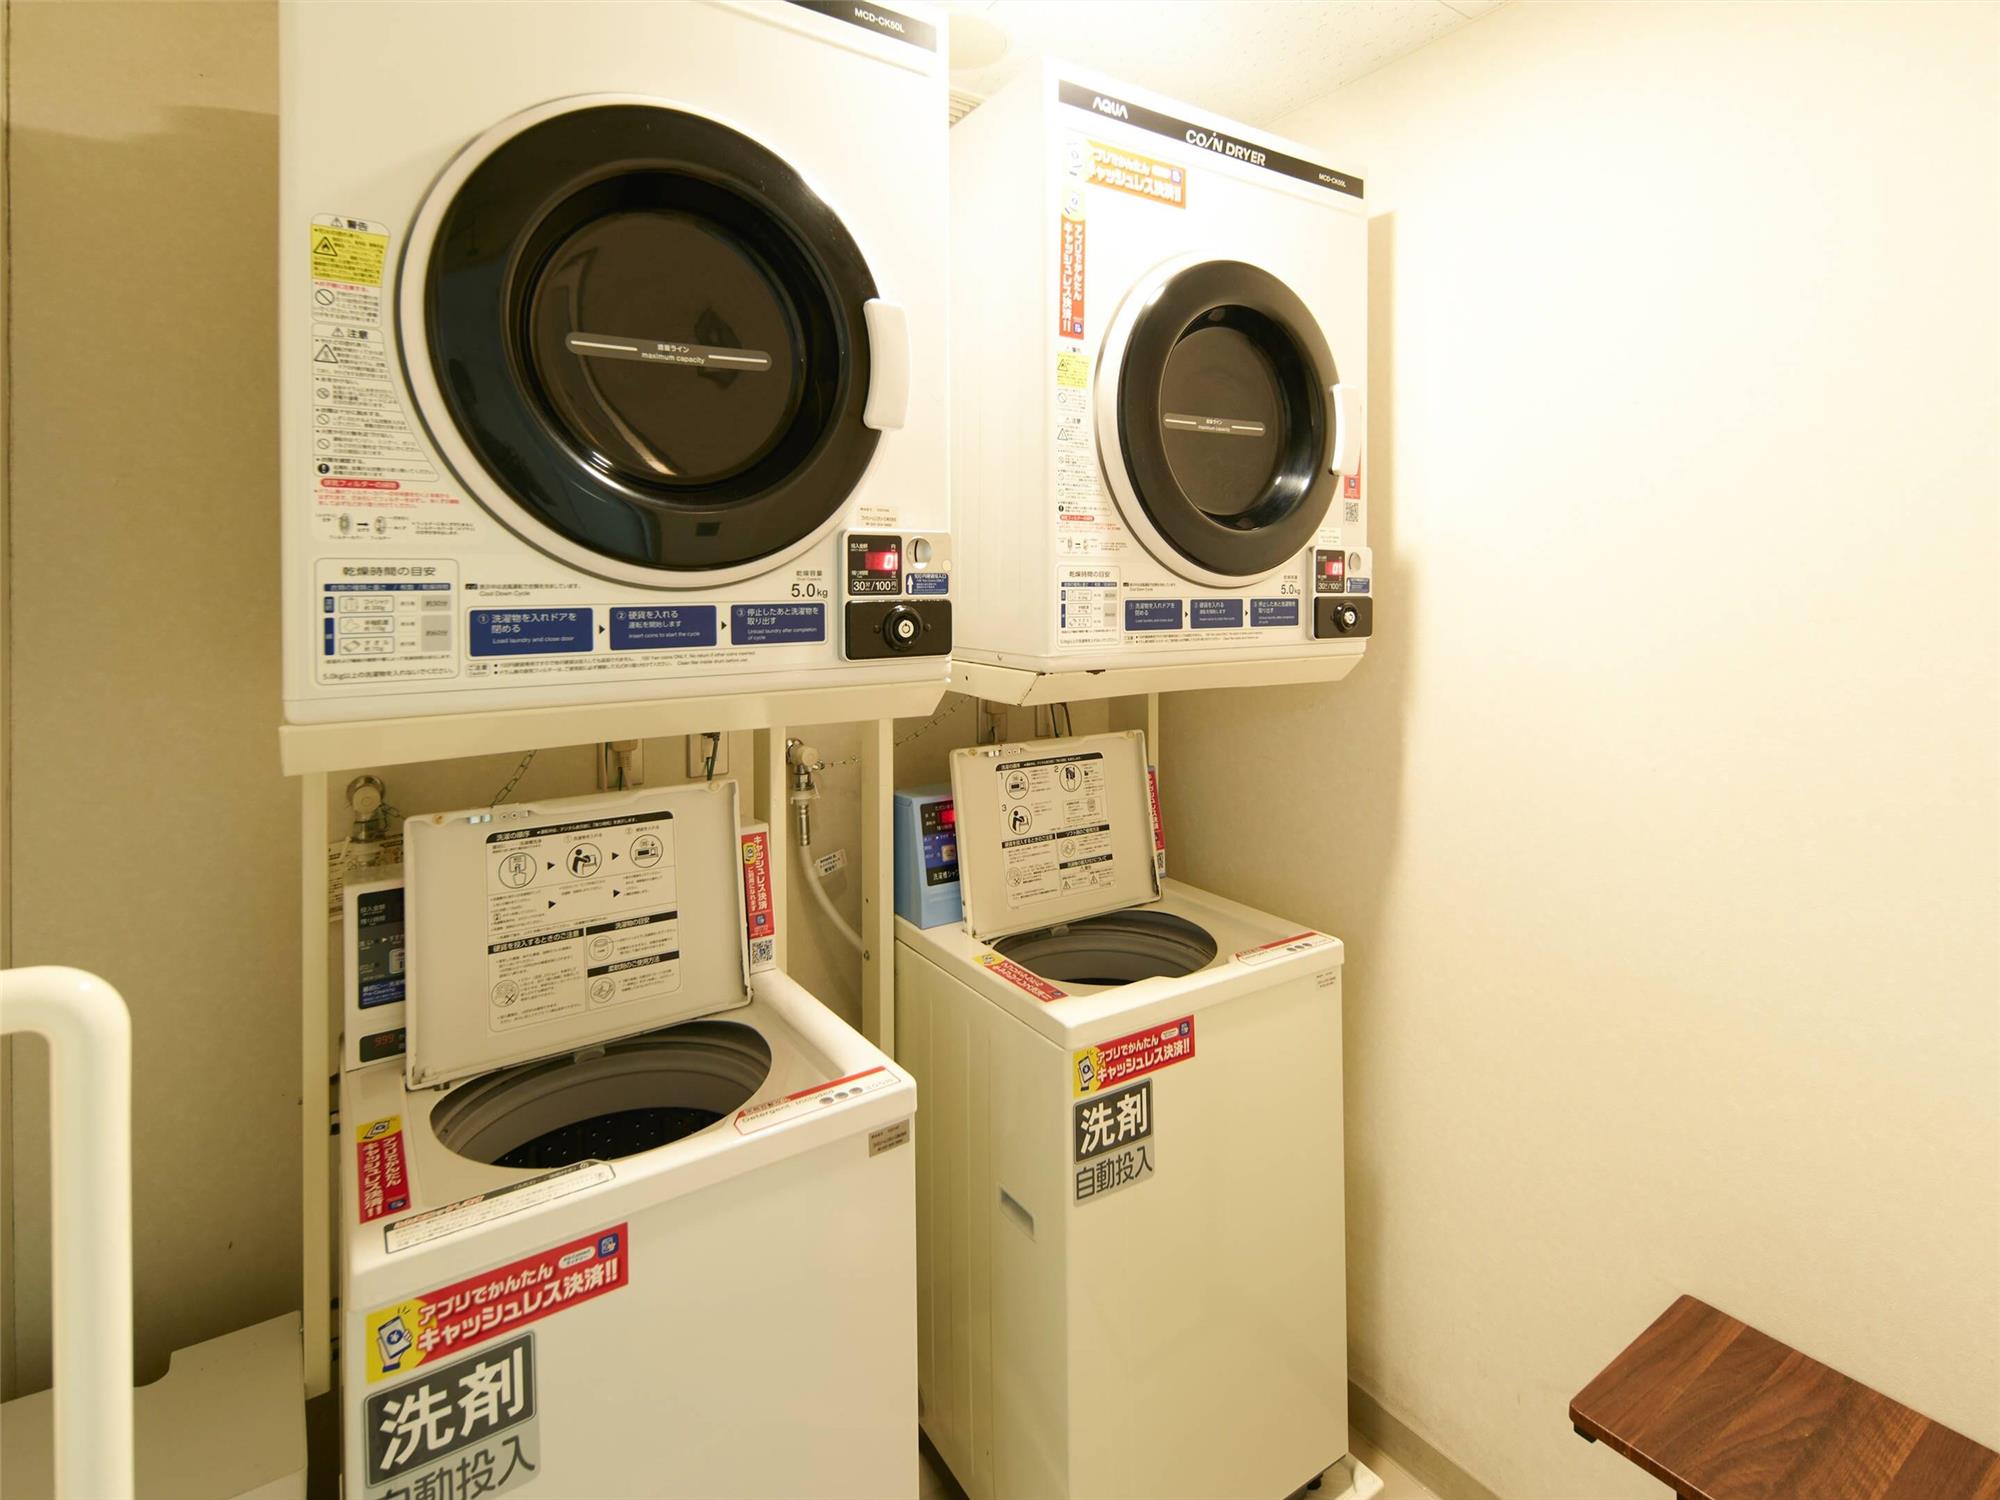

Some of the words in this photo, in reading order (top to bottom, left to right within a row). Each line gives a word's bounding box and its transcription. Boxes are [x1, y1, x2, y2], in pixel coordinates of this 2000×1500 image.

[1092, 96, 1128, 119] AQUA
[1225, 143, 1266, 166] DRYER
[348, 329, 368, 339] 注意
[642, 352, 675, 362] maximum
[676, 355, 705, 365] capacity
[343, 567, 436, 576] 乾燥時間の目安
[491, 612, 577, 623] 洗濯物を入れドアを
[628, 610, 678, 620] 硬貨を入れる
[747, 607, 819, 616] 停止したあと洗濯物を
[747, 617, 776, 625] 取り出す
[491, 624, 521, 634] 閉める
[628, 620, 681, 629] 運転を開始します
[1002, 804, 1007, 812] 3
[753, 835, 768, 909] キャッシュレス決済
[1097, 1034, 1158, 1064] アプリでかんたん
[1097, 1038, 1190, 1081] キャッシュレス決済!!
[1080, 1088, 1149, 1154] 洗剤
[1075, 1146, 1153, 1200] 自動投入
[416, 1257, 618, 1352] キャッシュレス決済!!
[418, 1263, 554, 1325] アプリでかんたん
[379, 1347, 525, 1471] 洗剤
[376, 1435, 535, 1500] 動投入
